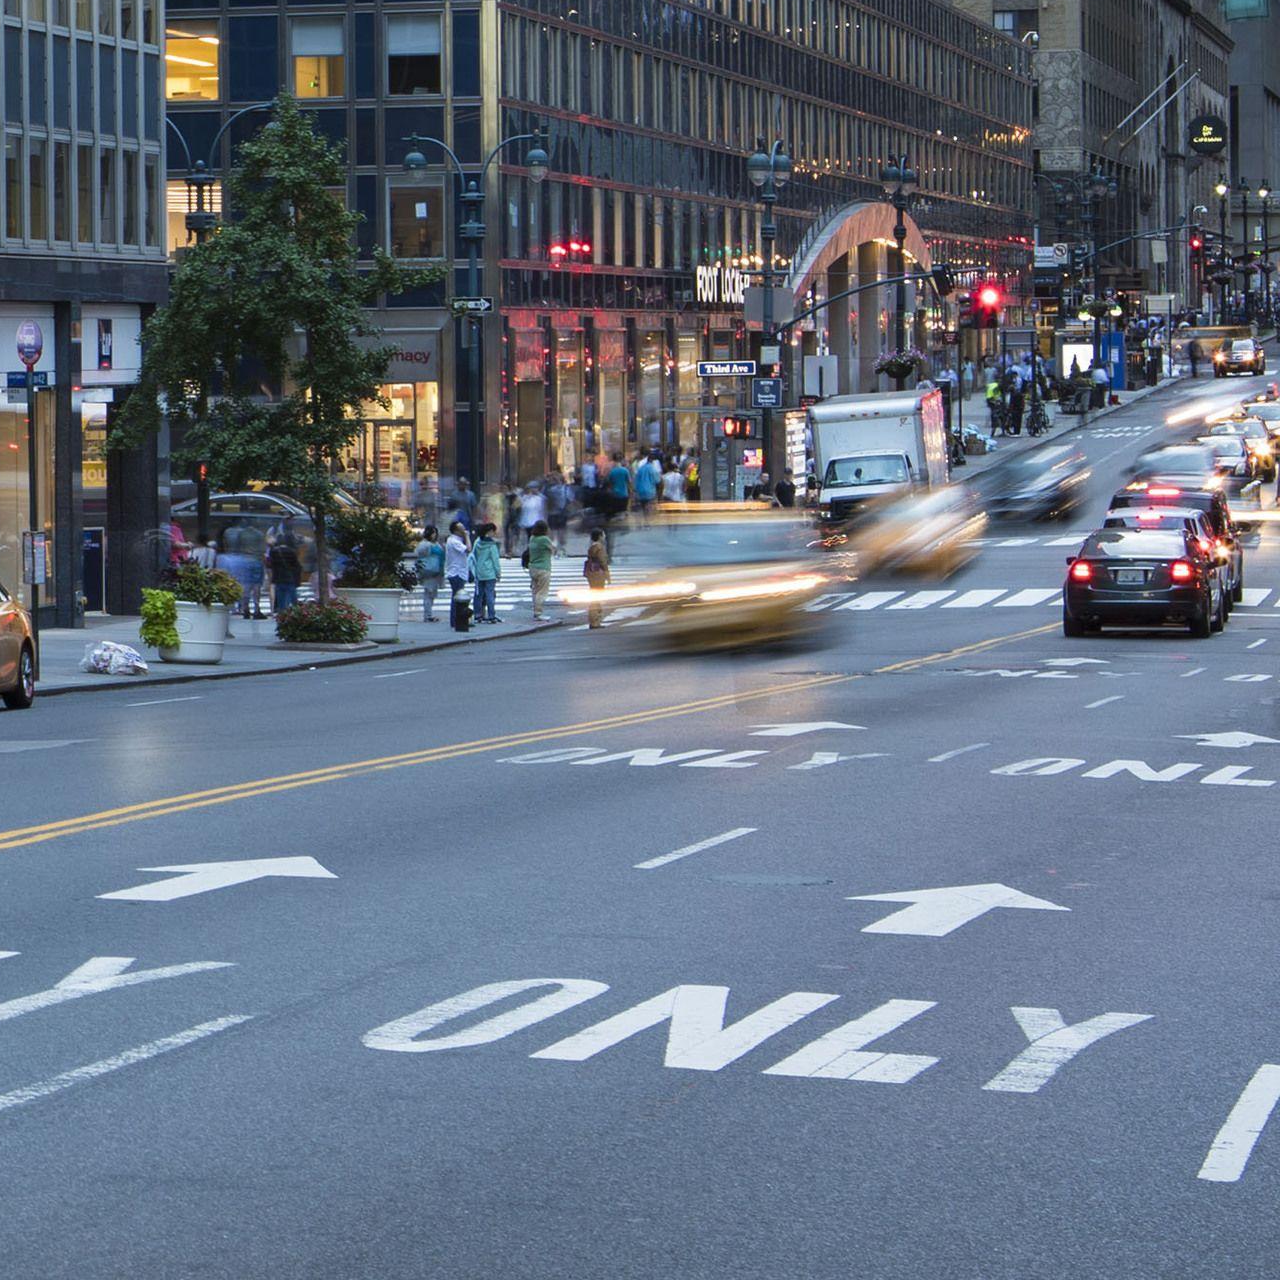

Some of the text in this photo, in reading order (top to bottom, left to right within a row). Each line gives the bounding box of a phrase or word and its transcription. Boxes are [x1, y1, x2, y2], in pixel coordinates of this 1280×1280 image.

[697, 264, 719, 303] FOOT
[390, 350, 432, 365] macy
[704, 364, 749, 374] Third Ave
[494, 746, 892, 770] ONLY
[360, 976, 1157, 1094] ONLY
